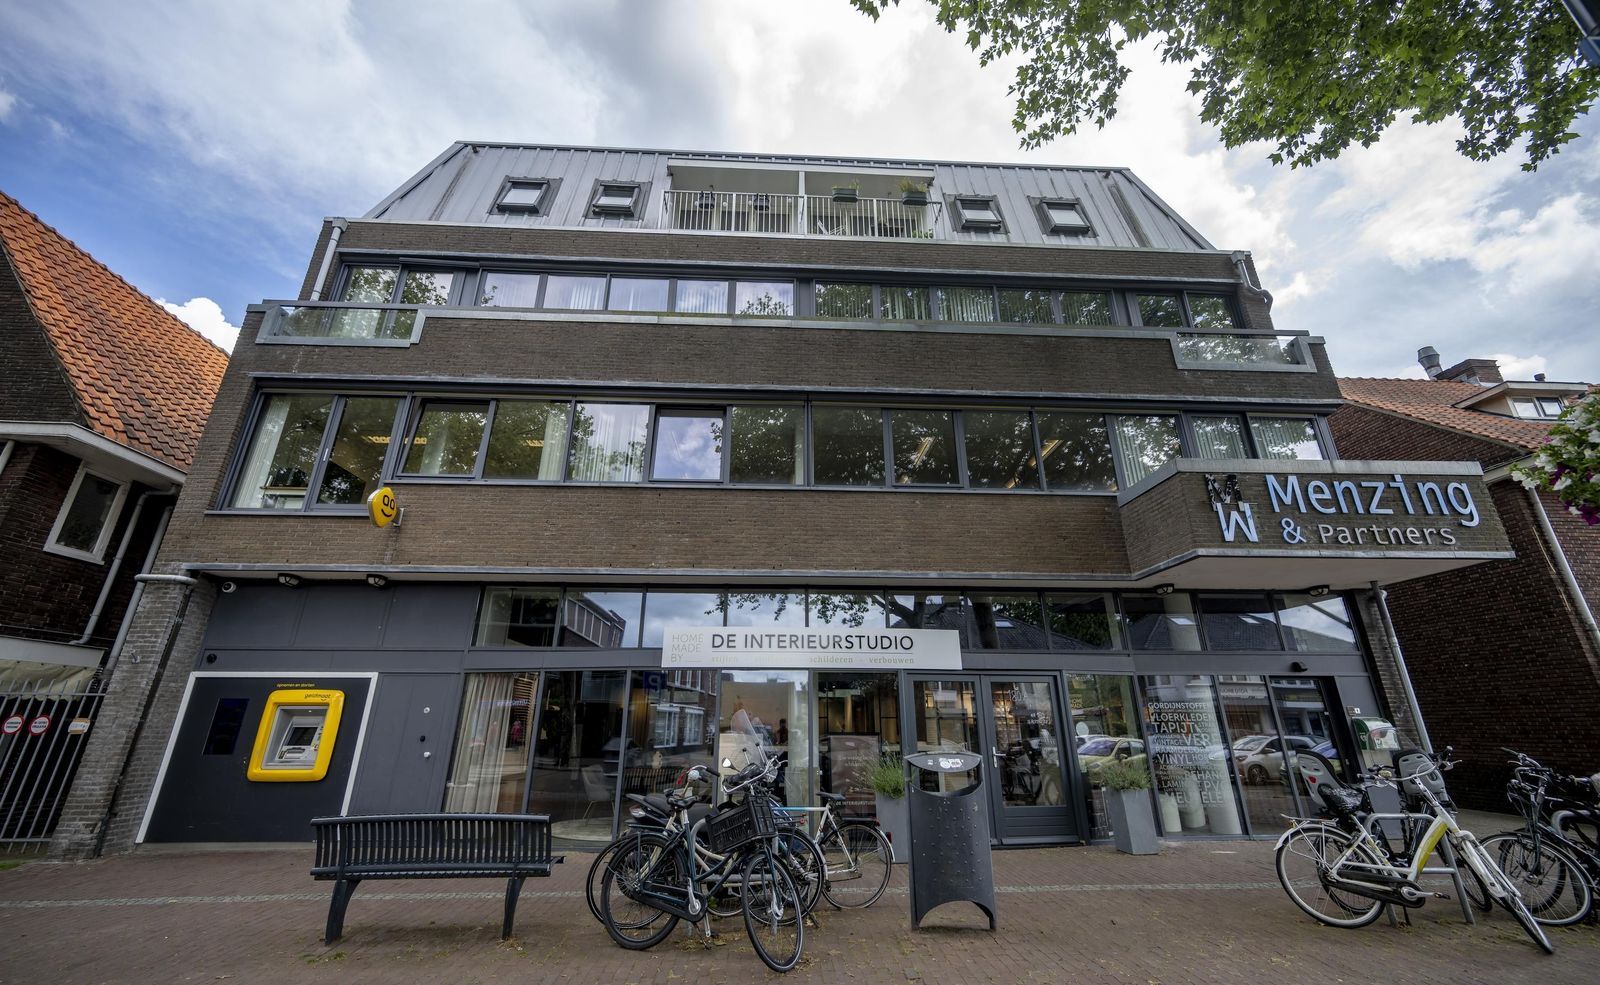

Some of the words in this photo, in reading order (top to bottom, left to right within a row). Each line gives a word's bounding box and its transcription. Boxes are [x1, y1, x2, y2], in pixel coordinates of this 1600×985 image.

[1265, 473, 1481, 528] Menzing
[1280, 517, 1307, 544] &
[1317, 523, 1457, 546] Partners
[672, 632, 704, 643] HOME
[711, 633, 737, 649] DE
[744, 633, 914, 651] INTERIEURSTUDIO
[671, 643, 702, 653] MADE
[671, 653, 684, 662] BY
[809, 655, 853, 664] schilderen
[868, 656, 914, 665] verbouwen
[1147, 702, 1213, 710] GORDIJNSTOFFE
[1151, 721, 1195, 734] TAPIJT
[1155, 745, 1221, 754] RAAMDECOR
[1157, 753, 1193, 765] VINYL
